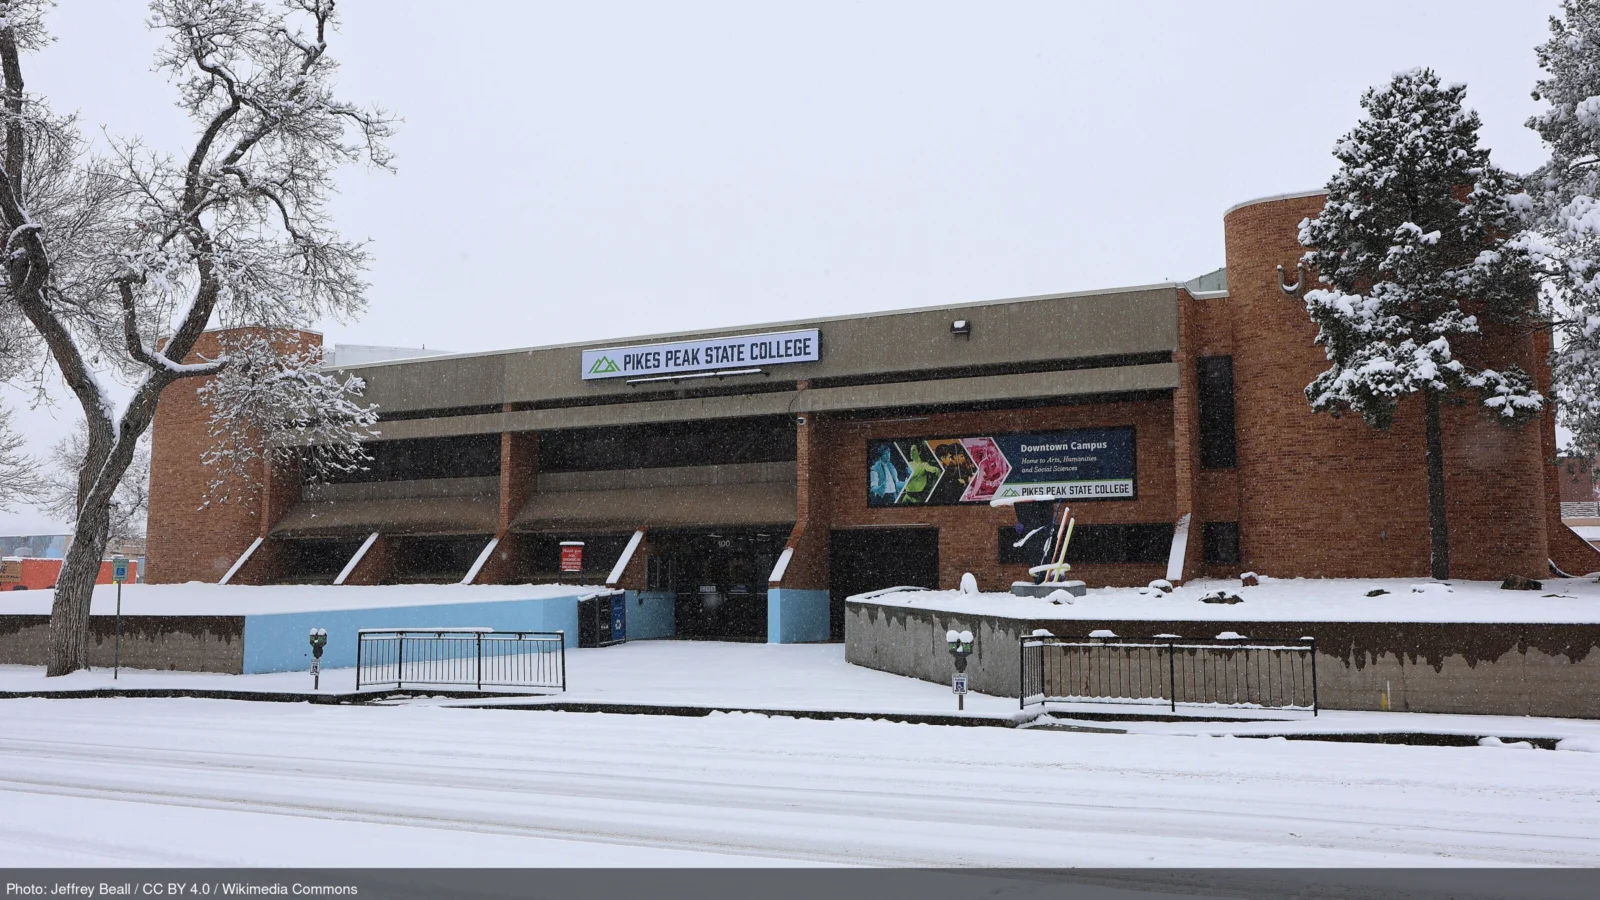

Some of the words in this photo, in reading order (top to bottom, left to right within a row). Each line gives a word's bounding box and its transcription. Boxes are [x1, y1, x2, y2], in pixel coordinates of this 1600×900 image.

[623, 351, 661, 371] PIKES
[665, 347, 700, 367] PEAK
[705, 343, 745, 364] STATE
[750, 337, 812, 360] COLLEGE
[1020, 443, 1068, 452] Downtown
[1070, 441, 1107, 451] Campus
[1022, 487, 1044, 496] PIKES
[1046, 486, 1066, 496] PEAK
[1069, 485, 1092, 495] STATE
[1094, 484, 1129, 494] COLLEGE
